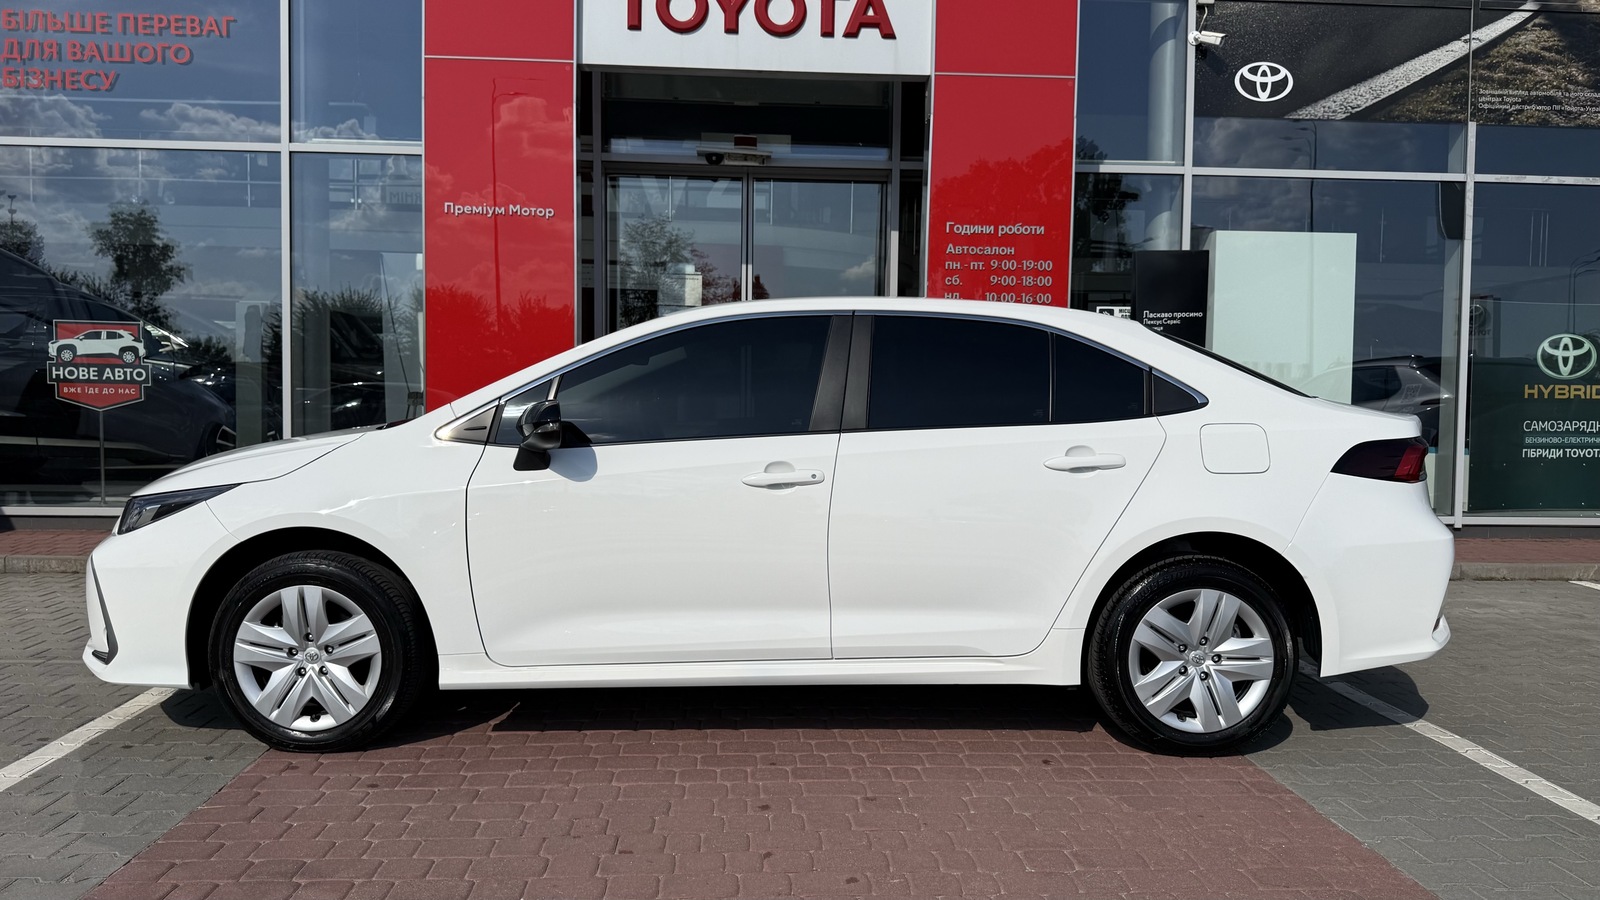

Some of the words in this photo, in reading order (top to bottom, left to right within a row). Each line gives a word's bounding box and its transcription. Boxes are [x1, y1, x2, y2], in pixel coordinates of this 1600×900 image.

[2, 9, 109, 33] БІЛЬШЕ
[117, 13, 235, 36] ПЕРЕВАГ
[1, 38, 58, 62] ДЛЯ
[67, 40, 192, 64] ВАШОГО
[2, 67, 117, 91] БІЗНЕСУ
[444, 202, 505, 217] Преміум
[509, 204, 555, 219] Мотор
[946, 222, 994, 236] Години
[998, 223, 1045, 237] роботи
[946, 243, 1015, 255] Автосалон
[945, 274, 963, 286] сб.
[1143, 310, 1173, 318] Ласкаво
[1173, 312, 1203, 320] просимо
[52, 366, 98, 380] НОВЕ
[102, 367, 146, 381] АВТО
[85, 385, 99, 394] ЇДЕ
[102, 387, 115, 395] ДО
[1522, 449, 1563, 459] ГІБРИДИ
[1565, 449, 1600, 458] TOYOT
